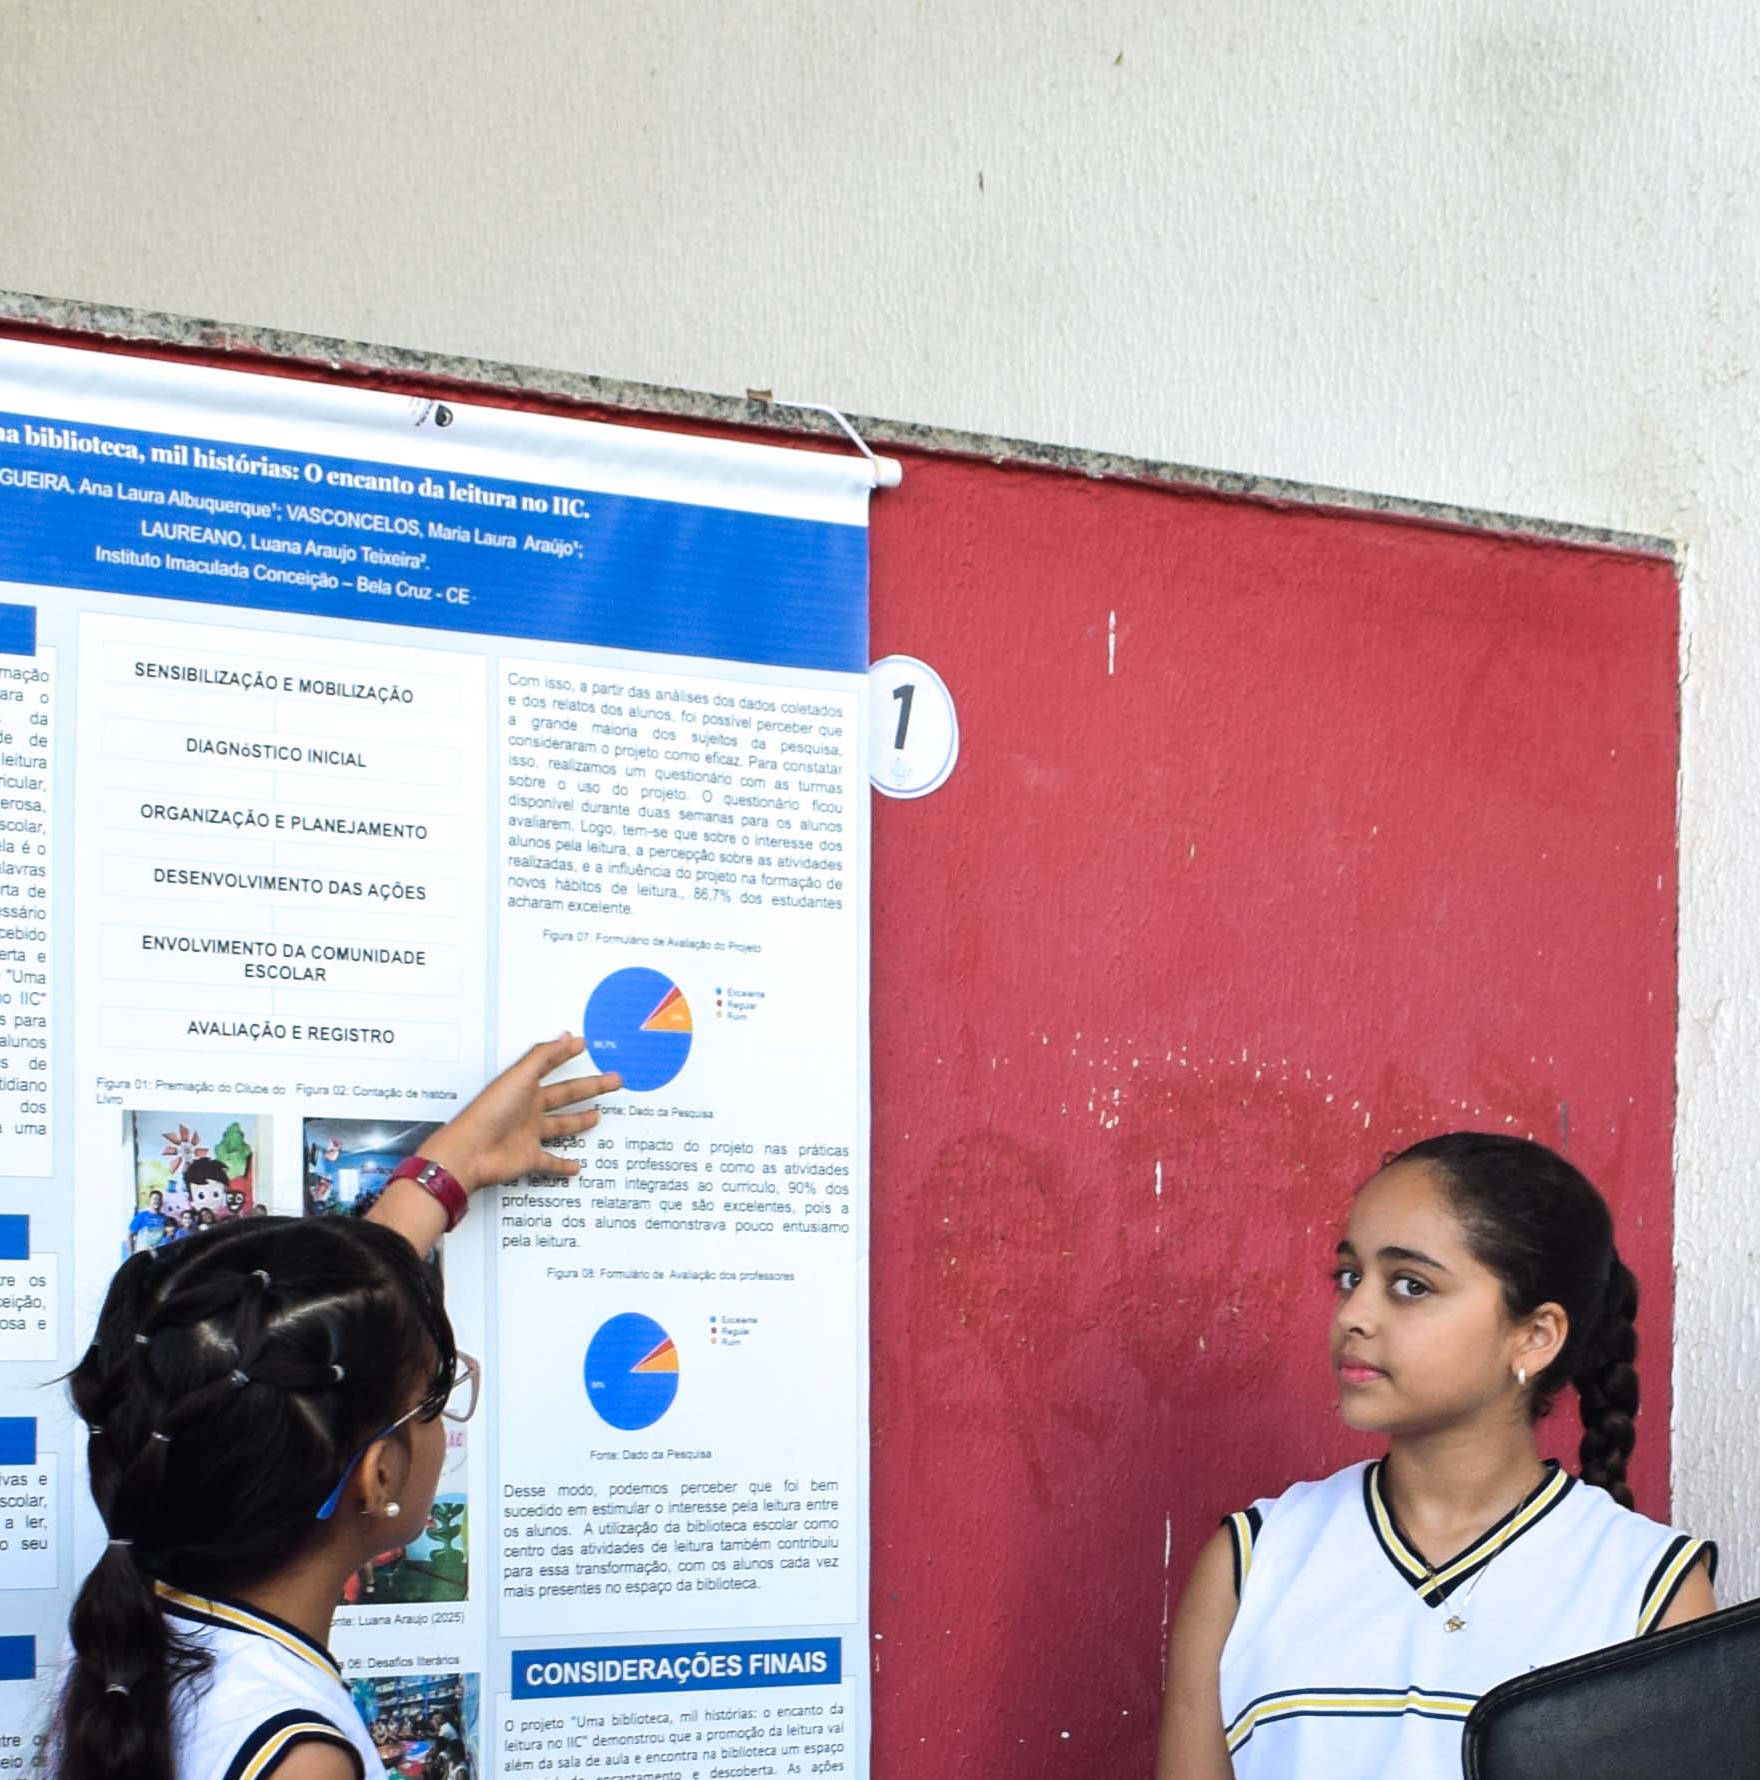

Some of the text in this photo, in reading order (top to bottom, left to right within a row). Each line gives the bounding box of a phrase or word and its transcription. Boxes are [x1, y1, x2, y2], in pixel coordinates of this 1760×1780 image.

[23, 424, 146, 464] biblioteca,
[149, 444, 188, 466] mil
[193, 446, 299, 480] histórias:
[303, 462, 323, 483] O
[325, 470, 415, 495] encanto
[417, 476, 445, 499] da
[448, 479, 517, 510] leitura
[521, 495, 549, 513] no
[552, 495, 591, 519] IIC.
[78, 477, 114, 498] Ana
[116, 482, 166, 505] Laura
[285, 503, 424, 538] VASCONCELOS,
[427, 521, 471, 543] Maria
[473, 527, 517, 549] Laura
[140, 519, 247, 550] LAUREANO,
[250, 532, 302, 555] Luana
[303, 539, 357, 564] Araujo
[94, 544, 162, 568] Instituto
[164, 553, 250, 579] Imaculada
[252, 563, 339, 591] Conceição
[355, 575, 392, 596] Bela
[394, 580, 432, 600] Cruz
[445, 586, 469, 605] CE
[39, 693, 49, 704] o
[134, 661, 413, 704] SENSIBILIZAÇÃO E MOBILIZAÇÃO
[893, 683, 915, 750] 1
[507, 715, 842, 757] a grande maioria dos sujeitos da pesquisa,
[308, 749, 367, 768] INICIAL
[140, 803, 427, 840] ORGANIZAÇÃO E PLANEJAMENTO
[154, 867, 426, 901] DESENVOLVIMENTO DAS AÇÕES
[142, 934, 426, 965] ENVOLVIMENTO DA COMUNIDADE
[244, 963, 326, 981] ESCOLAR
[187, 1020, 394, 1044] AVALIAÇÃO E REGISTRO
[500, 1192, 849, 1216] professores relataram que são excelentes, pois a
[4, 1518, 14, 1529] a
[503, 1577, 760, 1599] mais presentes no espaço da biblioteca.
[358, 1611, 465, 1626] Luana Araujo (2025)
[526, 1650, 827, 1686] CONSIDERAÇÕES FINAIS
